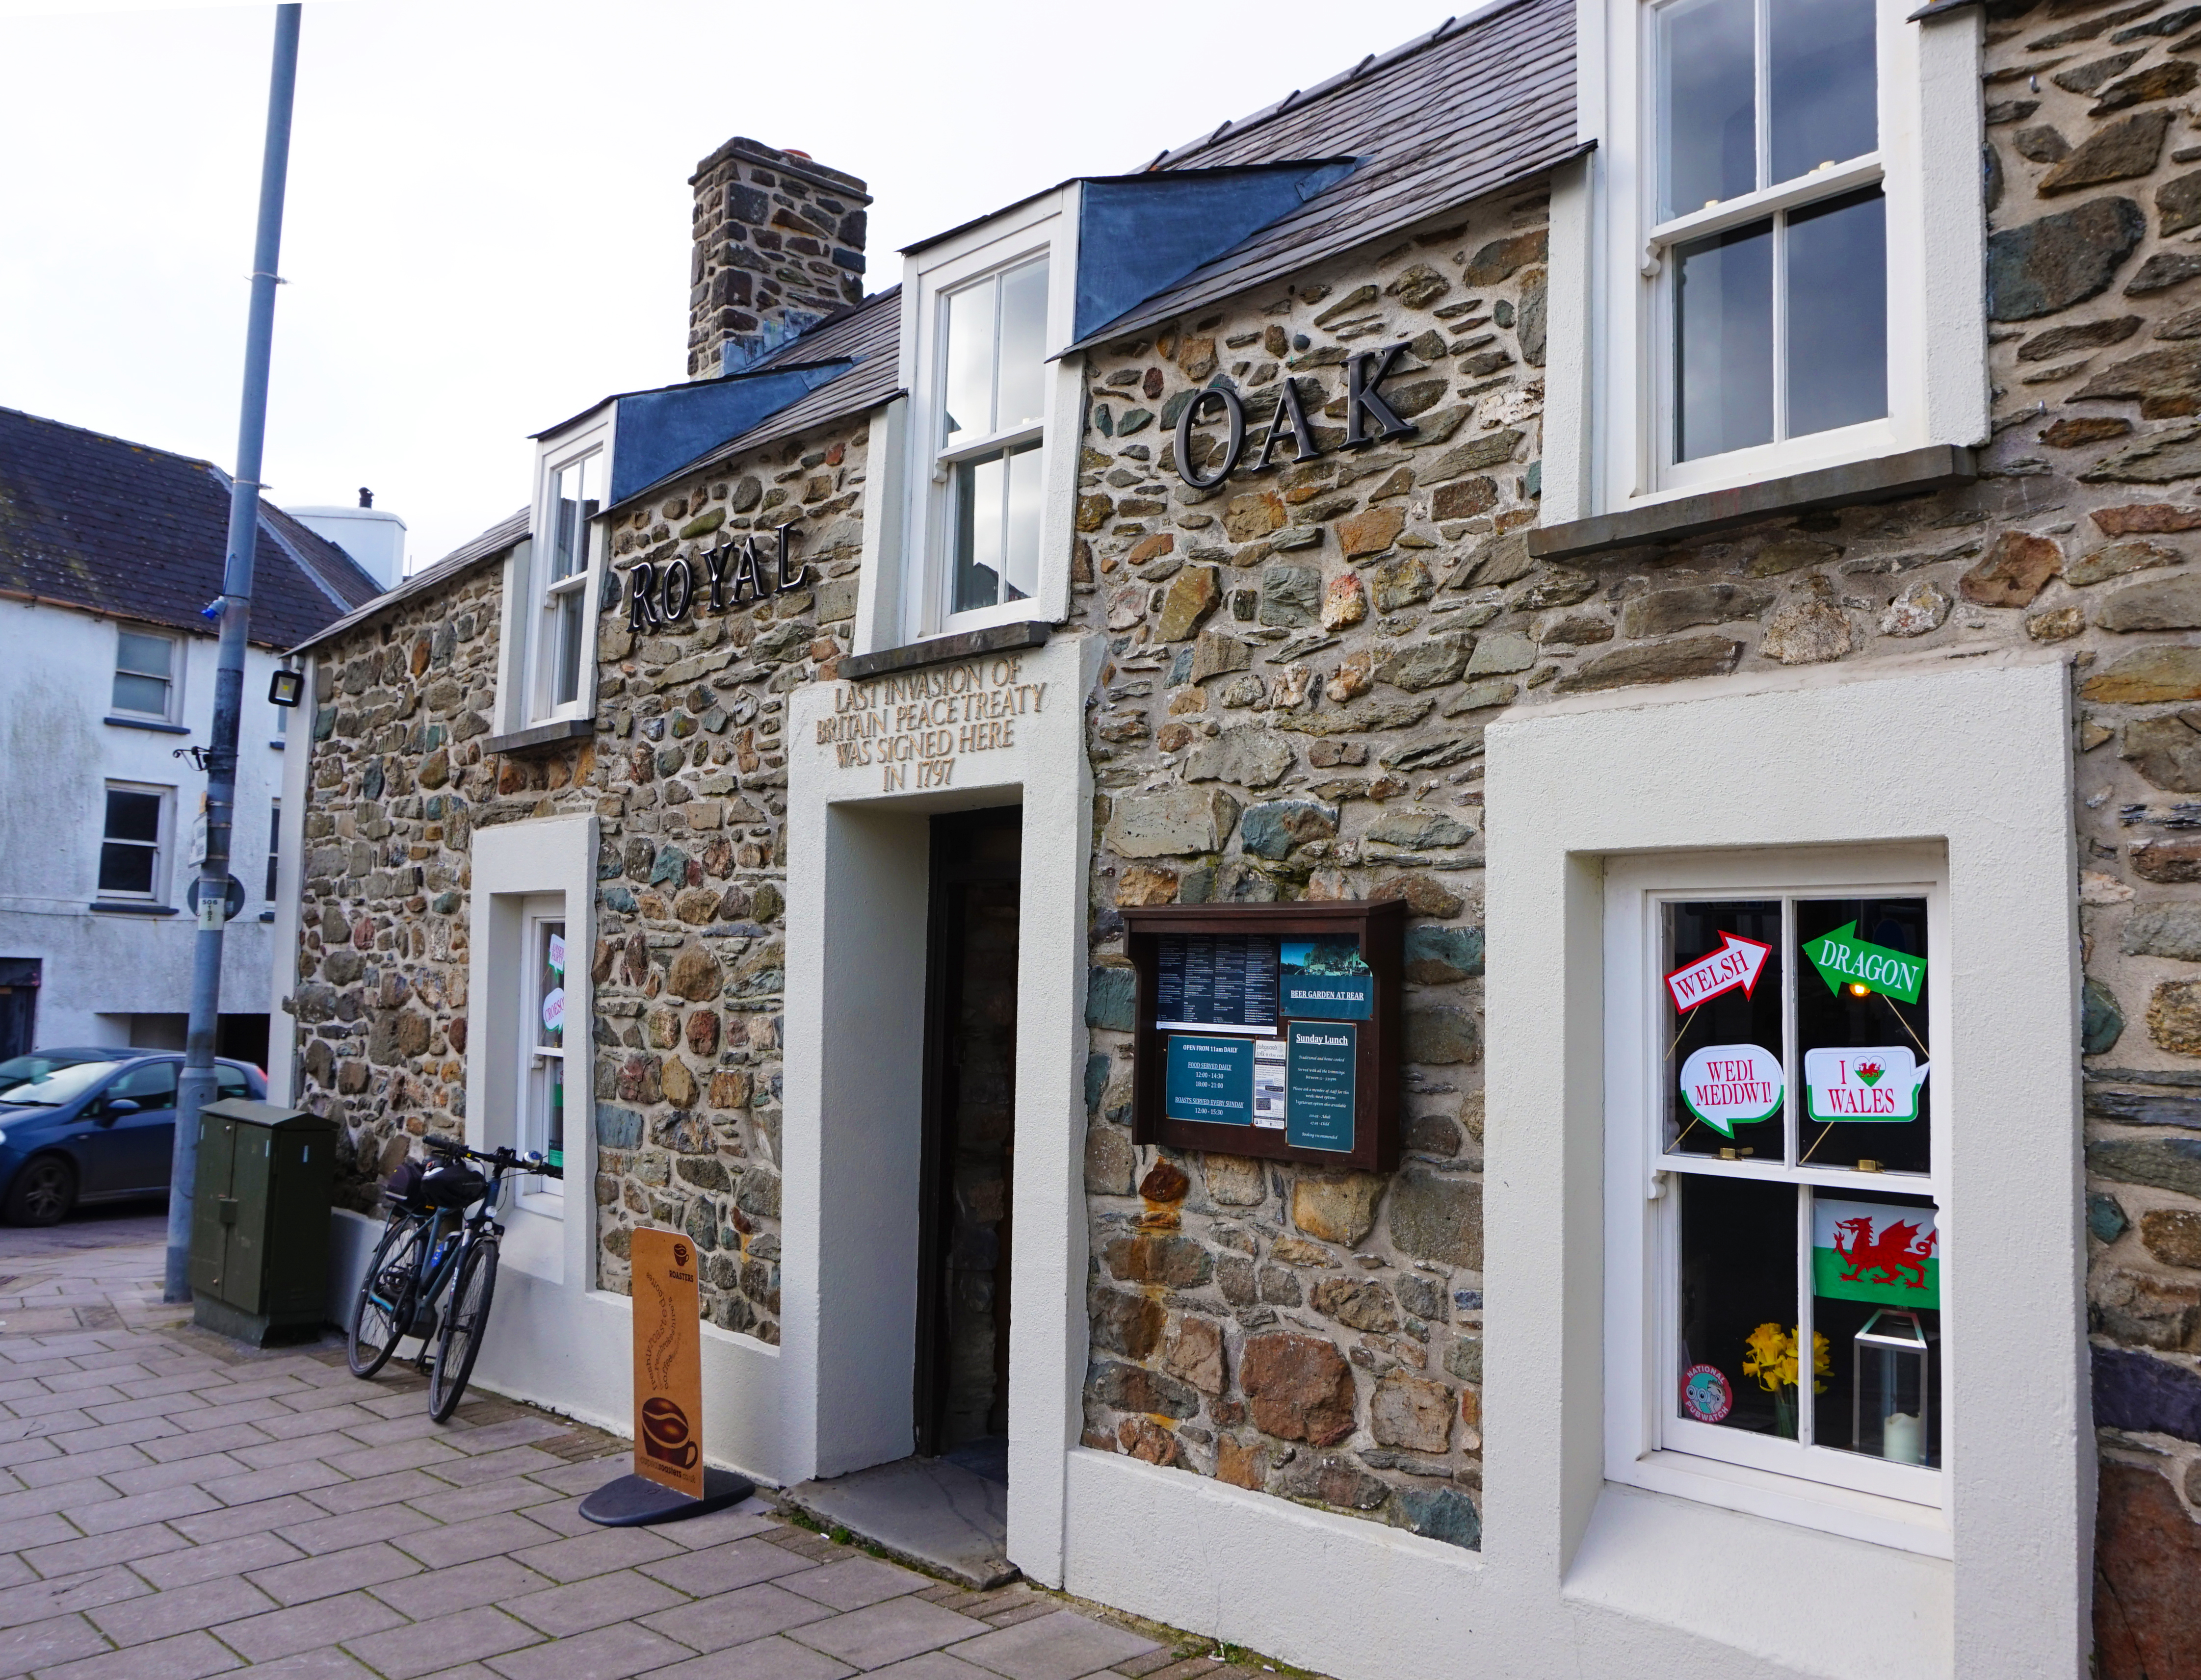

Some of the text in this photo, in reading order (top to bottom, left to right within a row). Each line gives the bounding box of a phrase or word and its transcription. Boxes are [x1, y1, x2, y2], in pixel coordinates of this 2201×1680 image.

[1173, 342, 1418, 489] OAK
[626, 521, 809, 633] ROYAL
[834, 655, 1022, 713] LAST INVASION OF
[816, 682, 1047, 744] BRITAIN PEACE TREATY
[836, 718, 1015, 769] WAS SIGNED HERE
[883, 758, 955, 791] IN 1797
[1675, 950, 1750, 1000] WELSH
[1818, 940, 1919, 992] DRAGON
[545, 996, 564, 1022] CROESO
[1296, 1034, 1348, 1045] Sunday Lunch
[1706, 1060, 1755, 1082] WEDI
[1839, 1060, 1846, 1084] I
[1695, 1082, 1772, 1106] MEDDWI!
[1828, 1088, 1894, 1113] WALES
[669, 1270, 694, 1283] ROASTERS
[1687, 1366, 1725, 1384] NATIONAL
[1685, 1400, 1729, 1421] PUBWATCH
